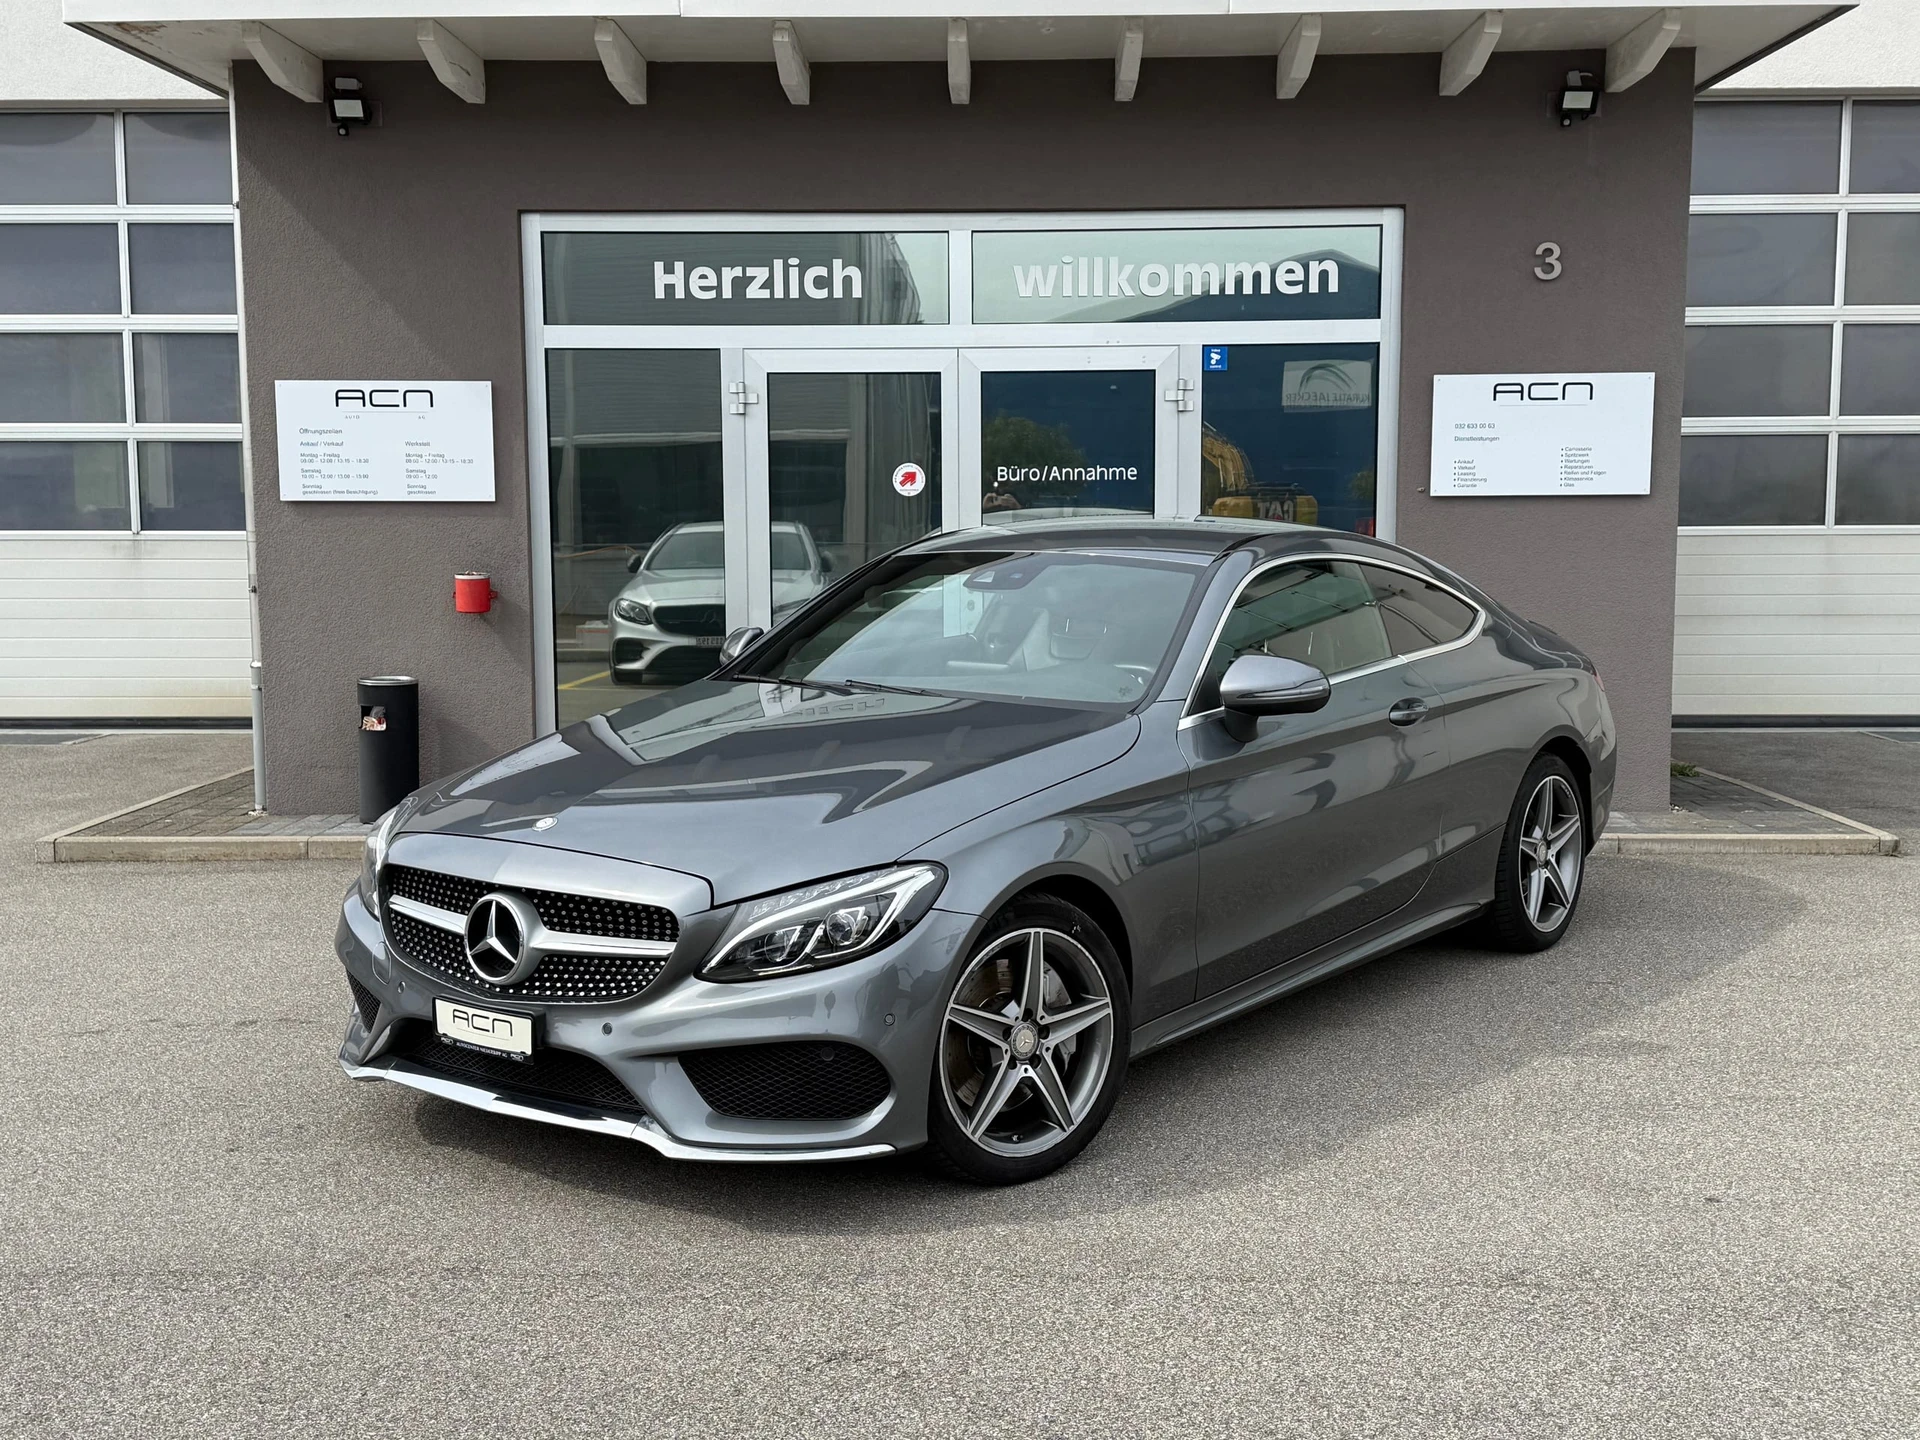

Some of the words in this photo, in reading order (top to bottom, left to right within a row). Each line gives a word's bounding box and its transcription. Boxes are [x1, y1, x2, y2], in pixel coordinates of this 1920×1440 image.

[1534, 242, 1562, 280] 3
[654, 257, 862, 299] Herzlich
[1013, 256, 1338, 297] willkommen
[335, 389, 434, 408] ACN
[1493, 382, 1593, 401] ACN
[997, 465, 1138, 481] Büro/Annahme
[453, 1009, 513, 1036] ACN
